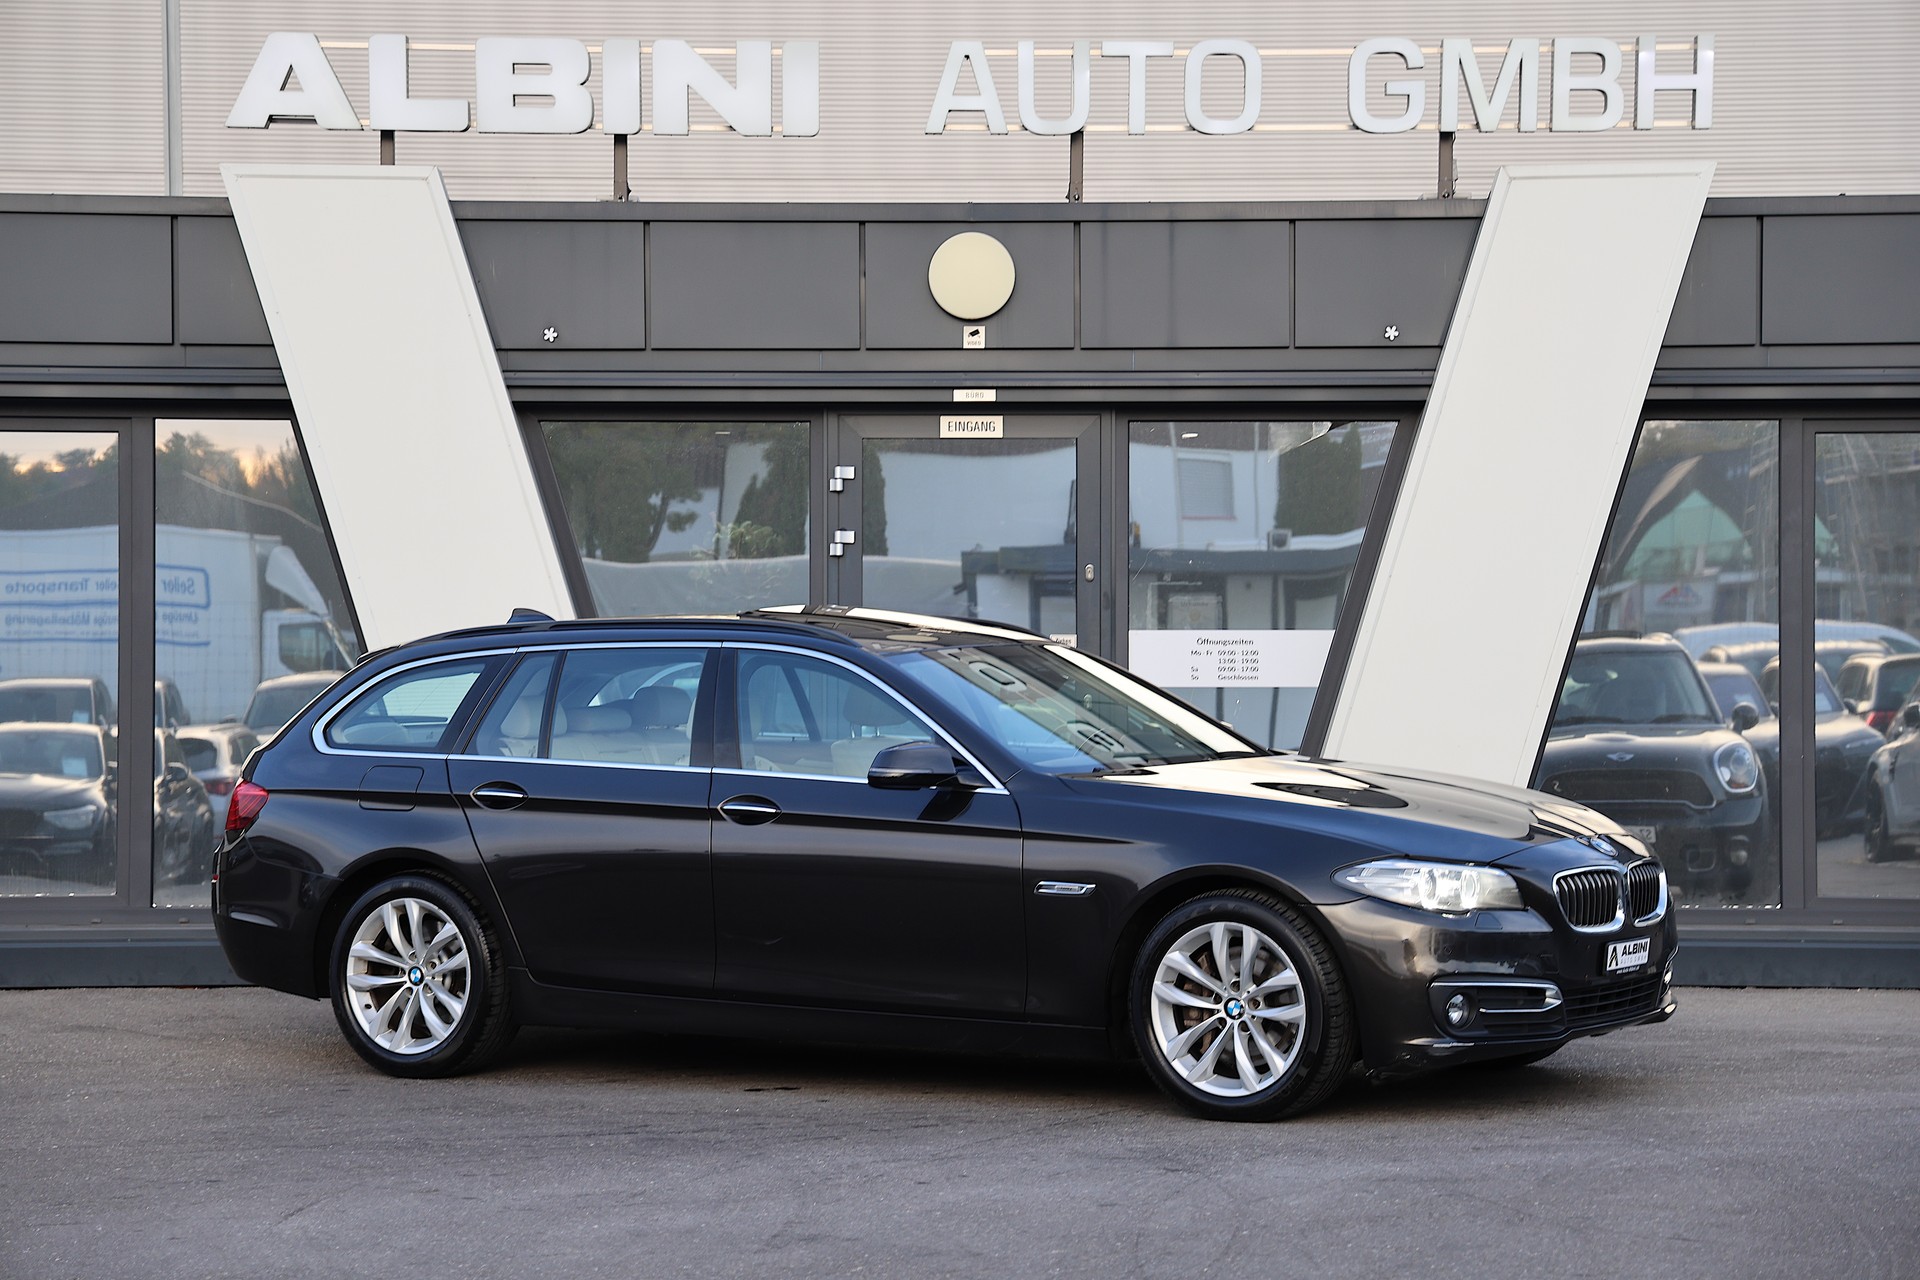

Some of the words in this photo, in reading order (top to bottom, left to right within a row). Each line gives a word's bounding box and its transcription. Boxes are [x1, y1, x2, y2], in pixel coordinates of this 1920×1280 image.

[225, 31, 820, 137] ALBINI
[925, 38, 1263, 135] AUTO
[1347, 33, 1716, 134] GMBH
[947, 420, 996, 432] EINGANG
[1196, 637, 1254, 646] Öffnungszeiten
[1621, 940, 1649, 957] ALBINI
